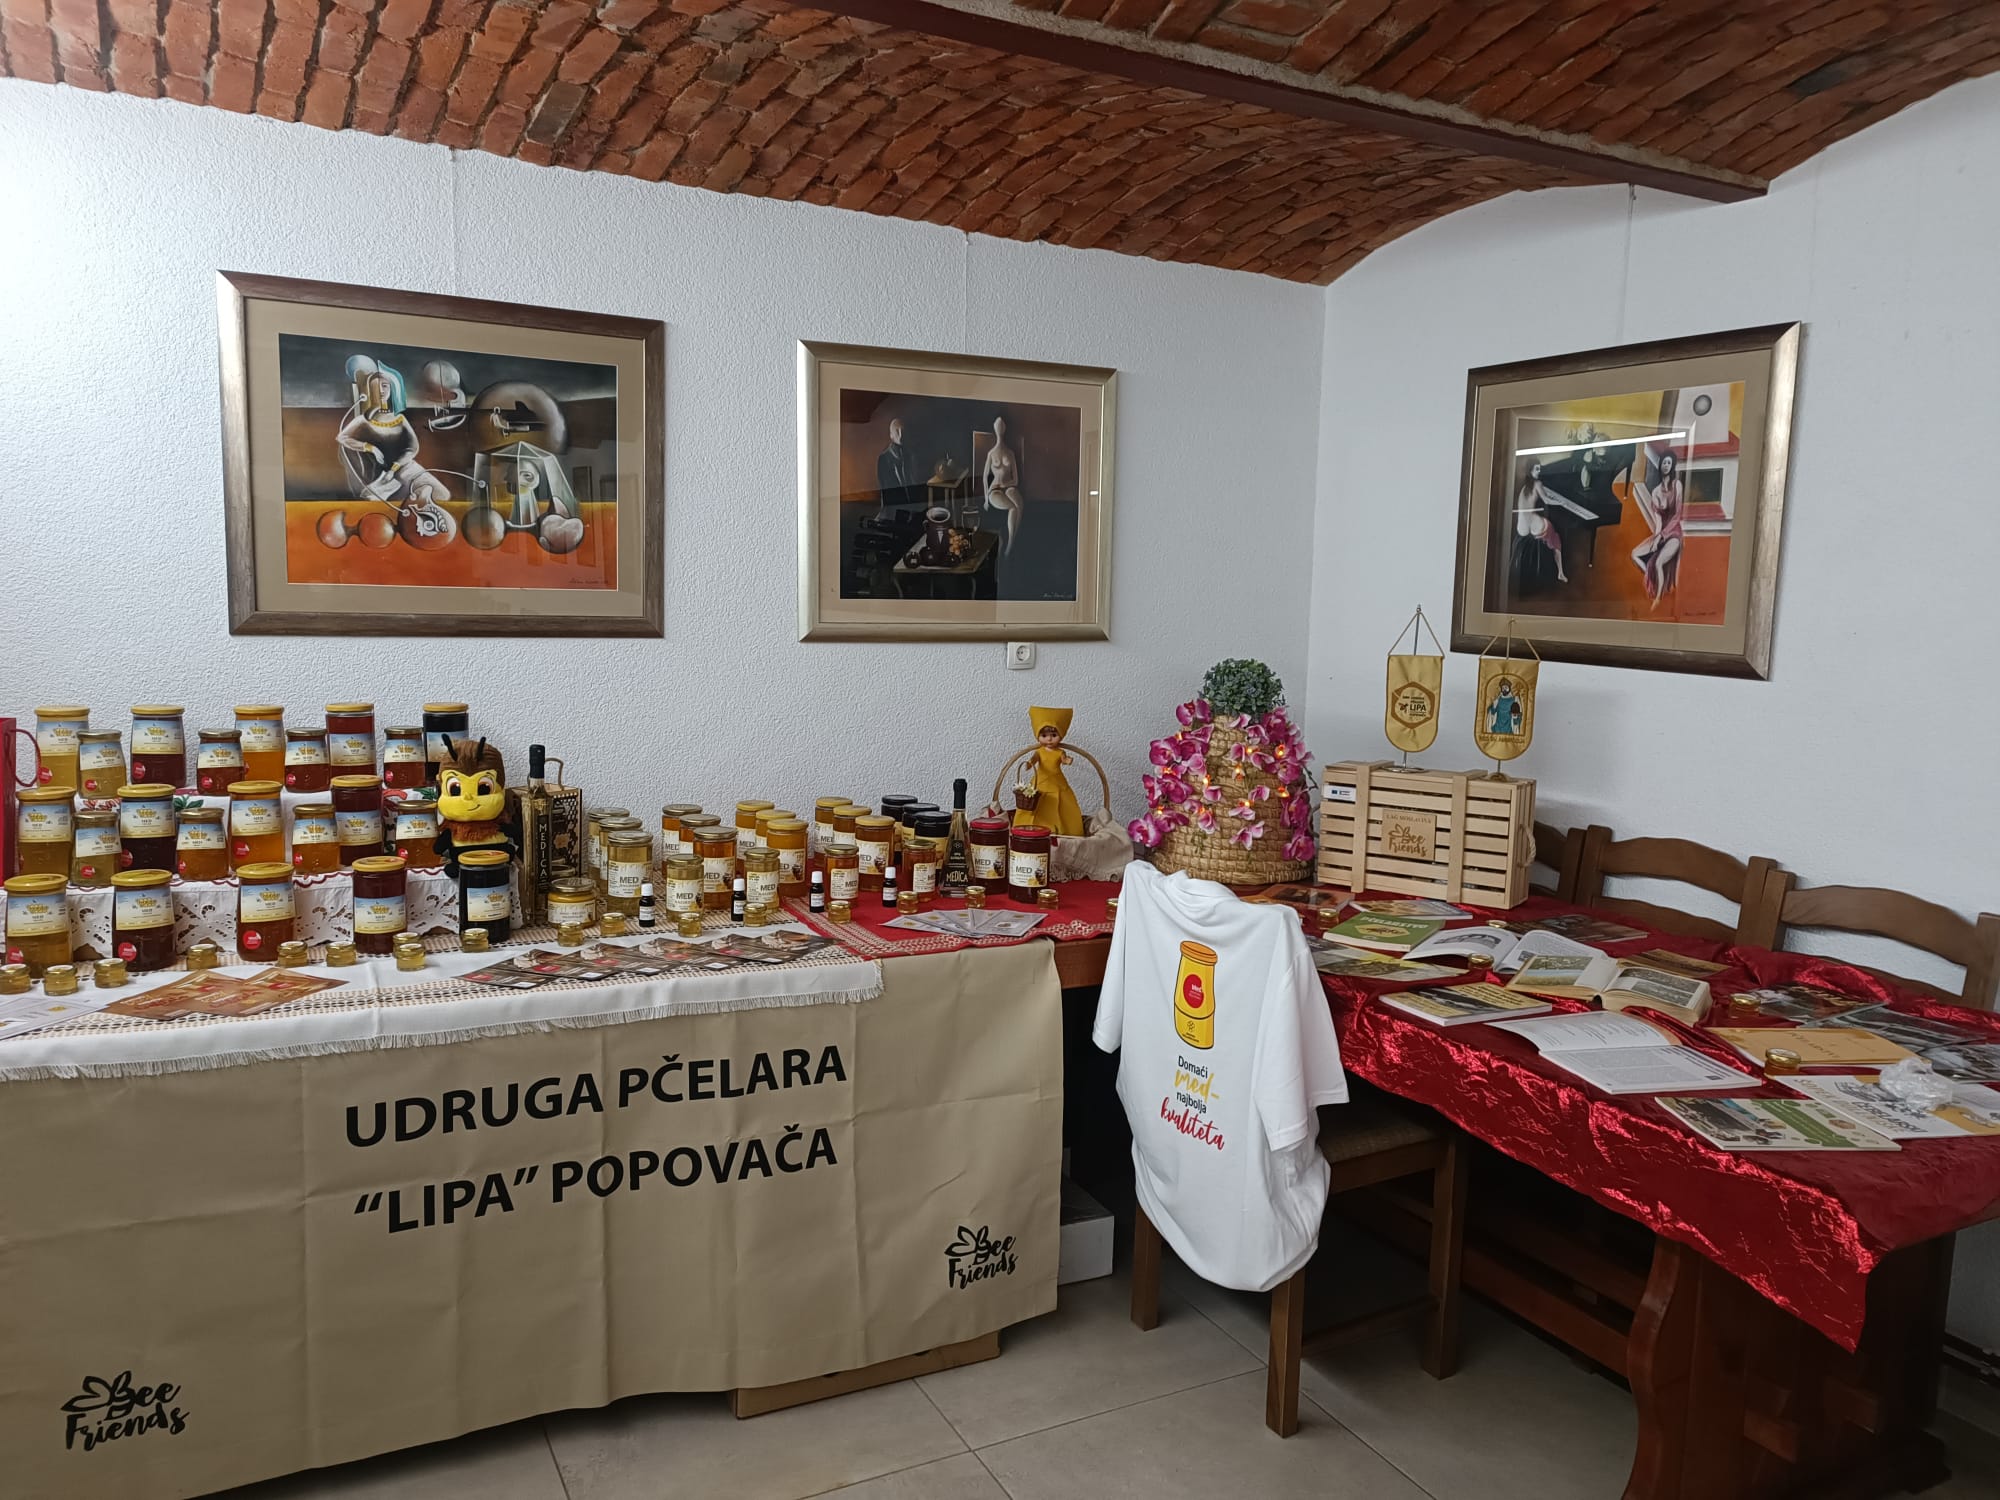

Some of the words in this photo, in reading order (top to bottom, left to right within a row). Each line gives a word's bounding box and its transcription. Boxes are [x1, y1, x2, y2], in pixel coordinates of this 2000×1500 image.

[1388, 823, 1426, 845] Bee
[1388, 836, 1428, 858] Friends
[539, 823, 548, 877] MEDICA
[619, 876, 639, 884] MED
[946, 870, 969, 882] MEDICA
[1015, 865, 1033, 873] MED
[676, 892, 694, 900] MED
[1177, 1056, 1208, 1078] Domaći
[346, 1073, 603, 1147] UDRUGA
[618, 1045, 847, 1108] PČELARA
[1176, 1092, 1207, 1114] najbolja
[1161, 1097, 1224, 1150] kvaliteta
[551, 1124, 837, 1203] POPOVAČA
[944, 1226, 1017, 1266] Bee
[948, 1251, 1019, 1289] Friends
[61, 1370, 182, 1421] Bee
[65, 1402, 190, 1451] Friends
